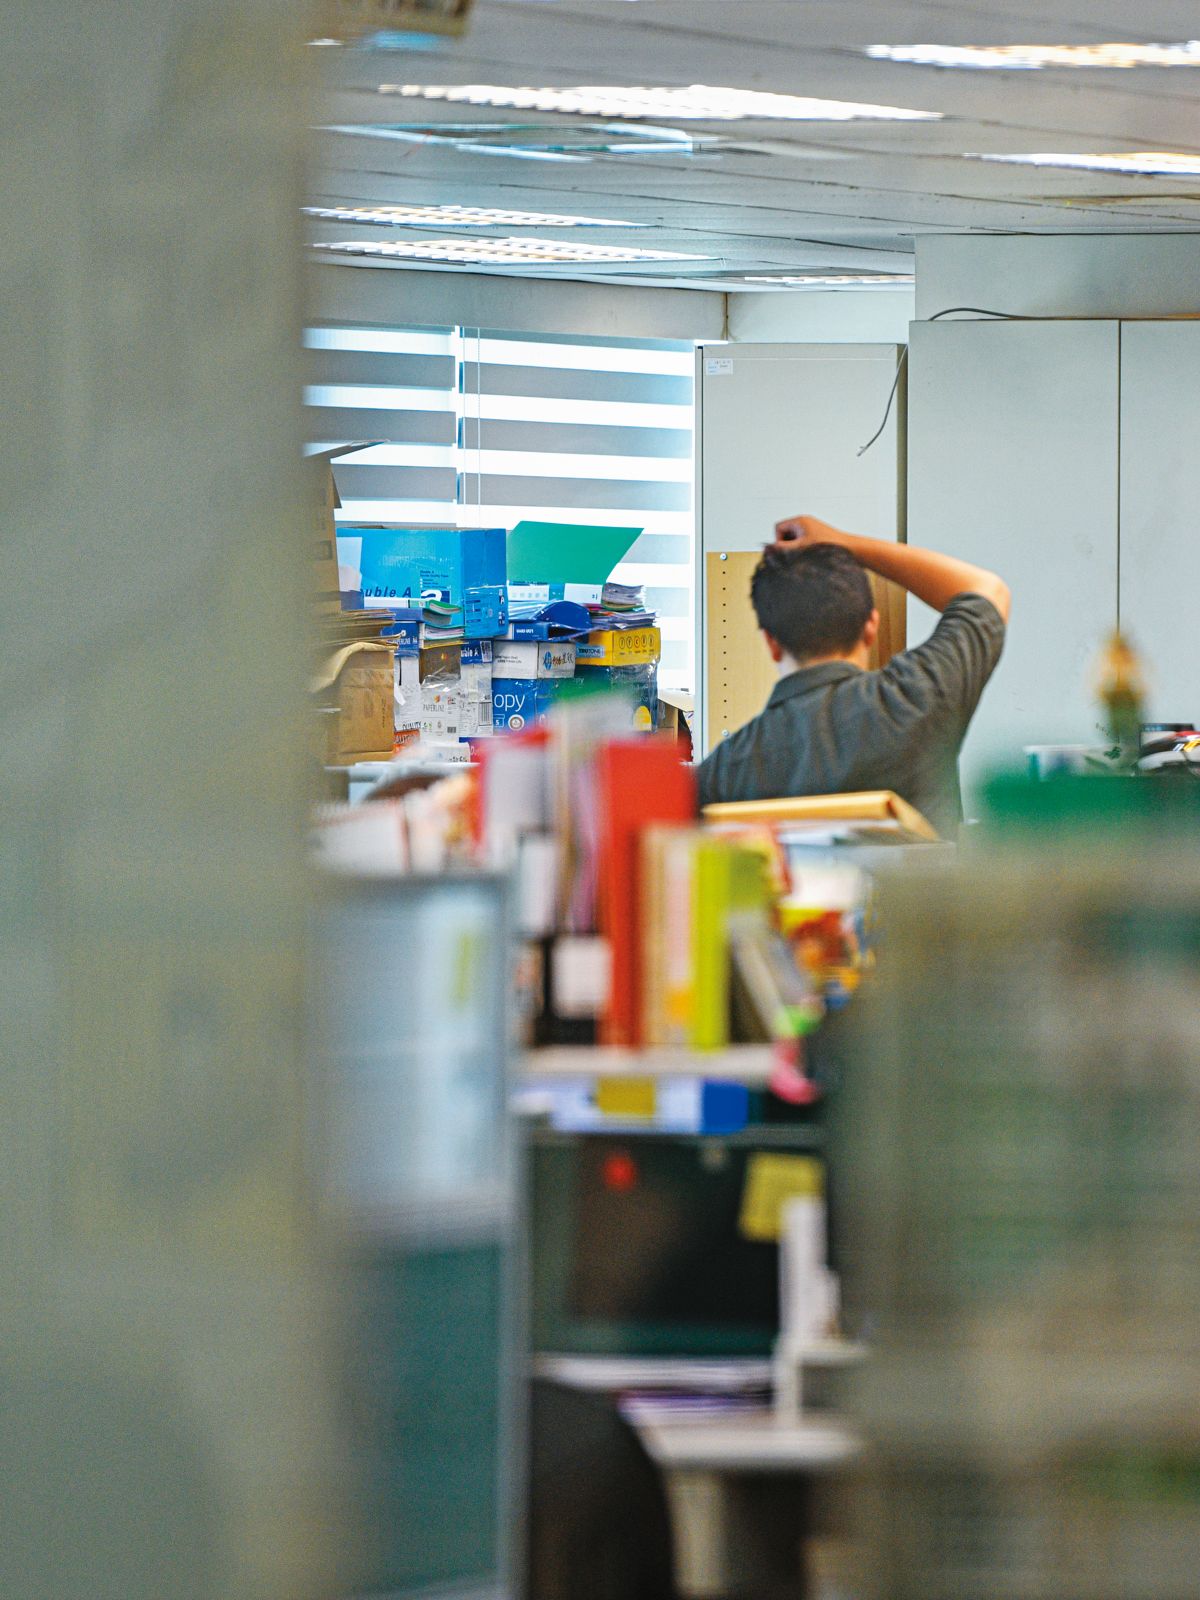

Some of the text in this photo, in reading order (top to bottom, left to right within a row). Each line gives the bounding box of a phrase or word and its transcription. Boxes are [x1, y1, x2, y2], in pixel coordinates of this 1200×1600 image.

[361, 587, 412, 598] uble A
[494, 694, 526, 712] opy
